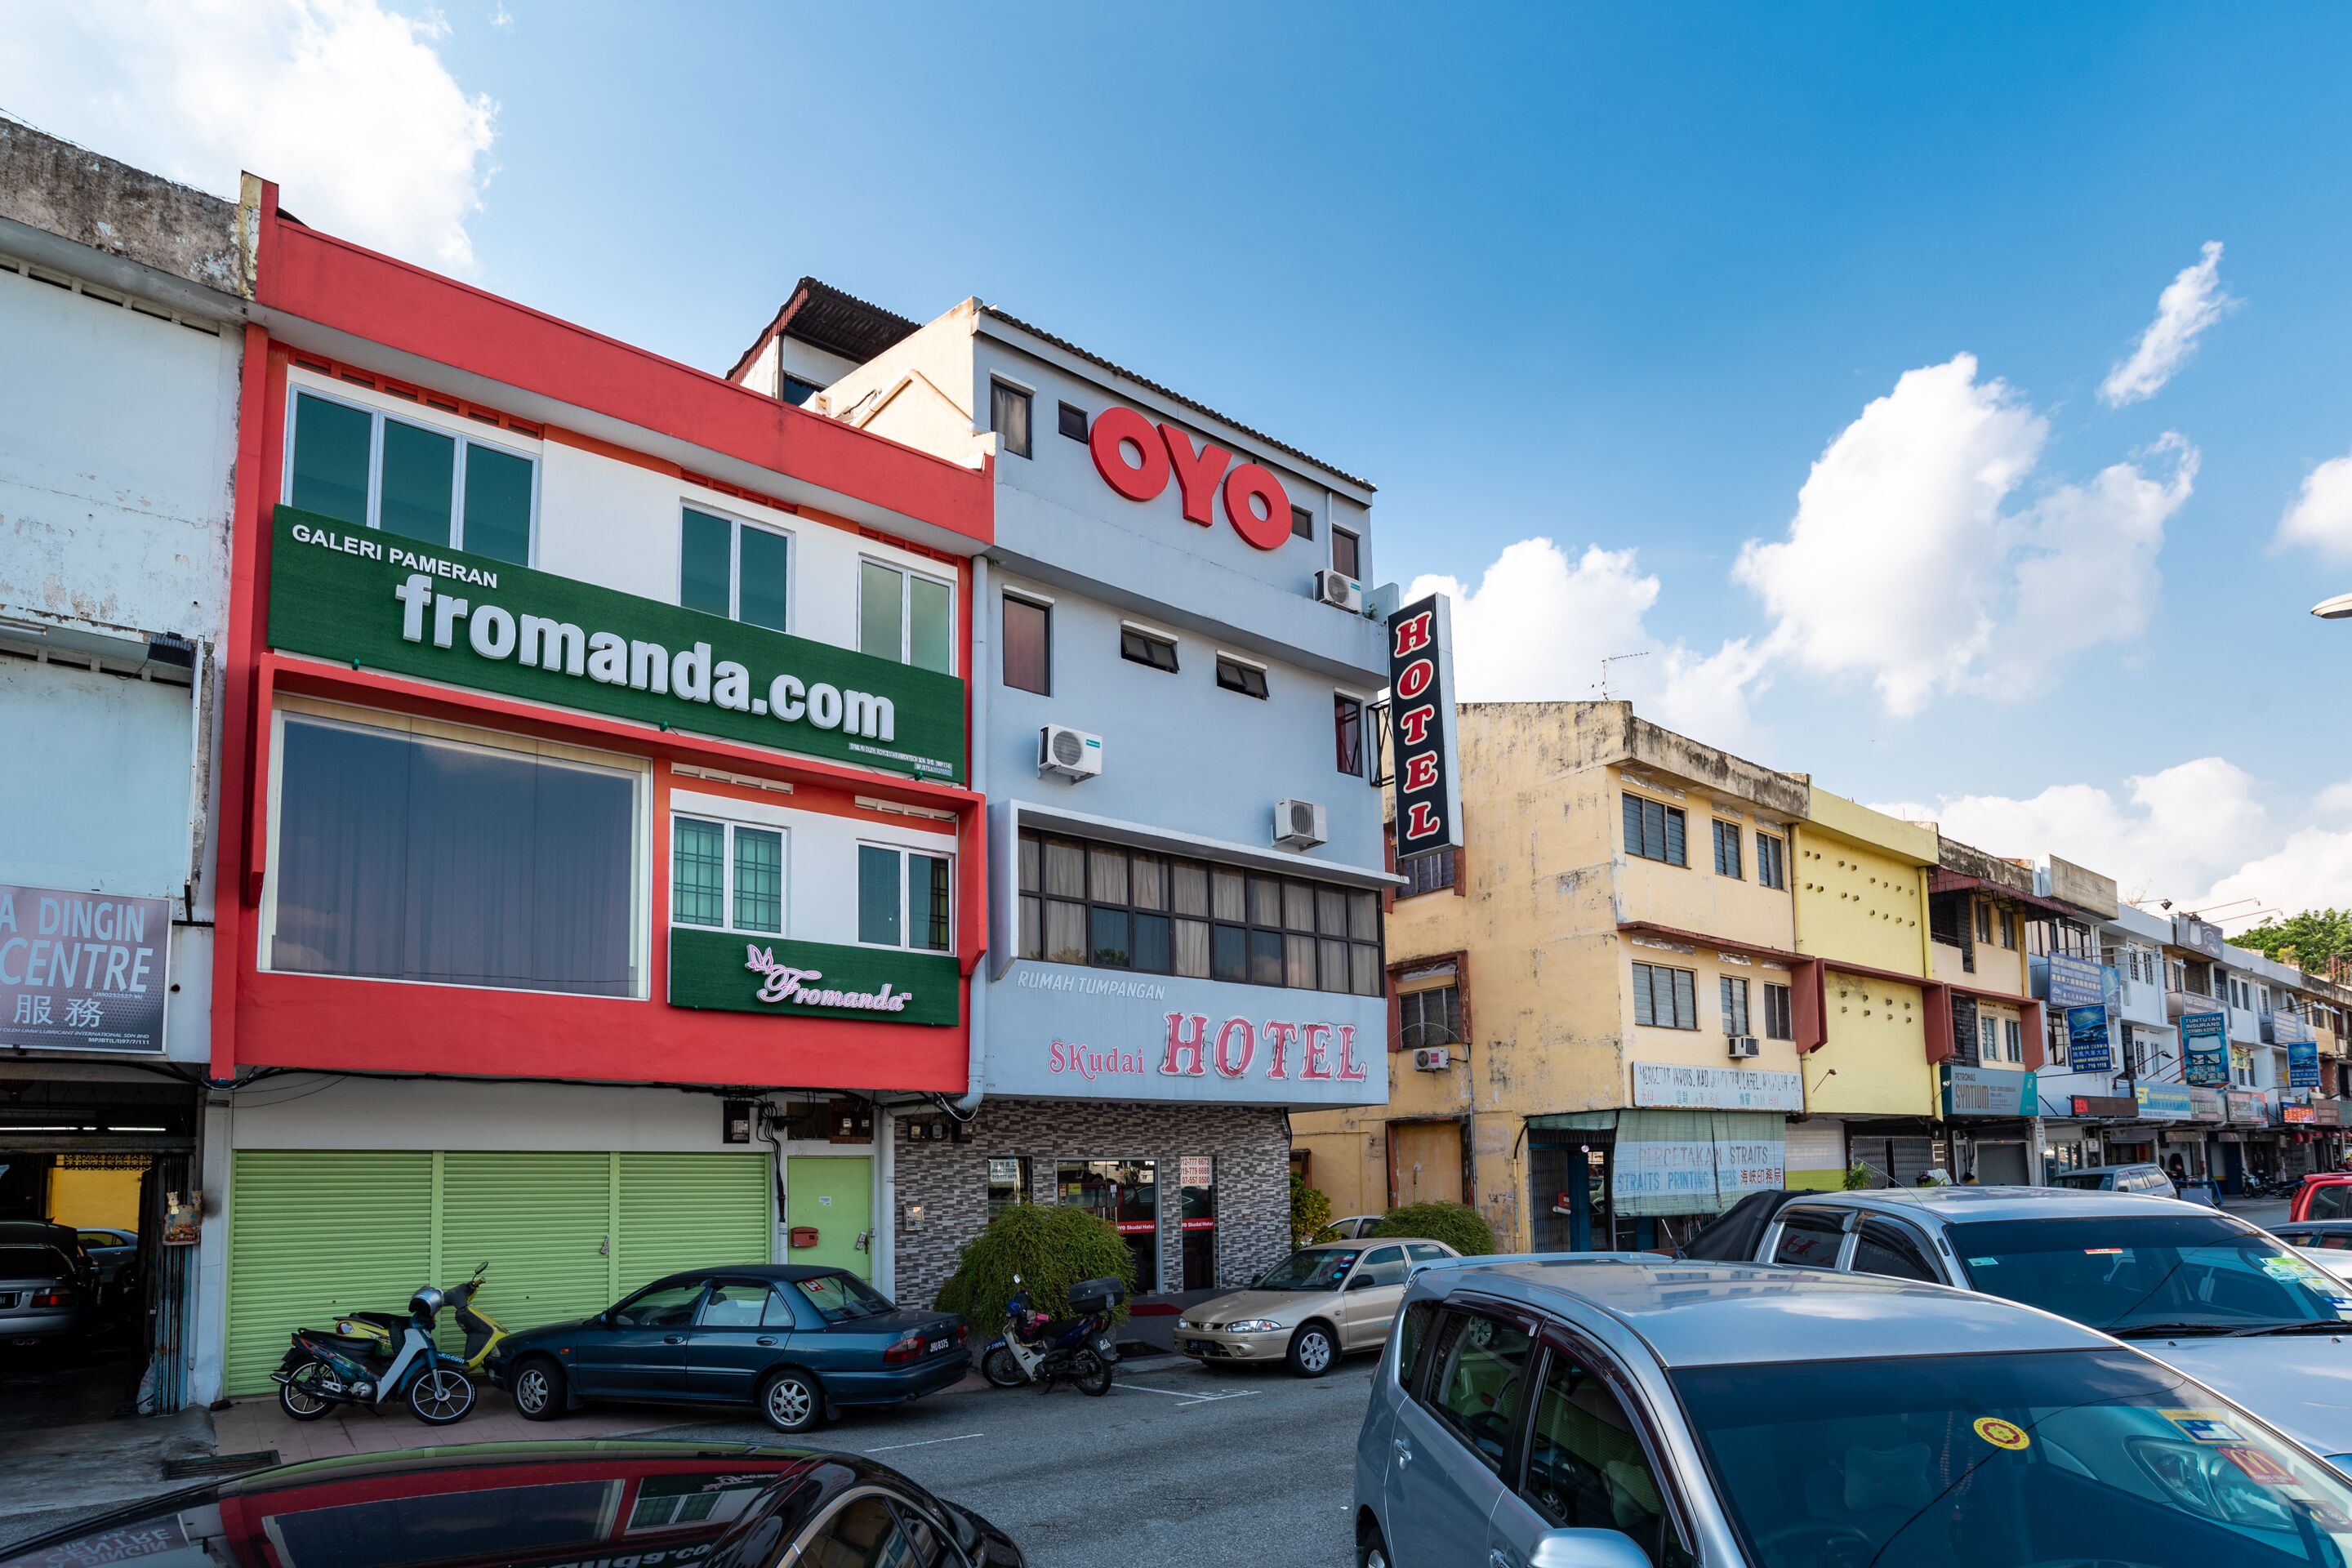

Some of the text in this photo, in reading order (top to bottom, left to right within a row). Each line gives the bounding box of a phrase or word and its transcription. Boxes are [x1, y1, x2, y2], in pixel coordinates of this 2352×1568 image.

[1089, 406, 1293, 550] OYO
[292, 523, 498, 589] GALERI PAMERAN
[395, 574, 895, 742] fromanda.com
[1393, 610, 1441, 841] HOTEL
[38, 897, 145, 942] DINGIN
[0, 937, 154, 993] CENTRE
[756, 964, 905, 1012] Fromanda
[1016, 970, 1165, 1000] RUMAH TUMPANGAN
[1159, 1011, 1369, 1083] HOTEL
[1618, 1173, 1660, 1192] STRAITS
[1668, 1171, 1709, 1190] PRINTING
[1731, 1146, 1768, 1165] STRAITS
